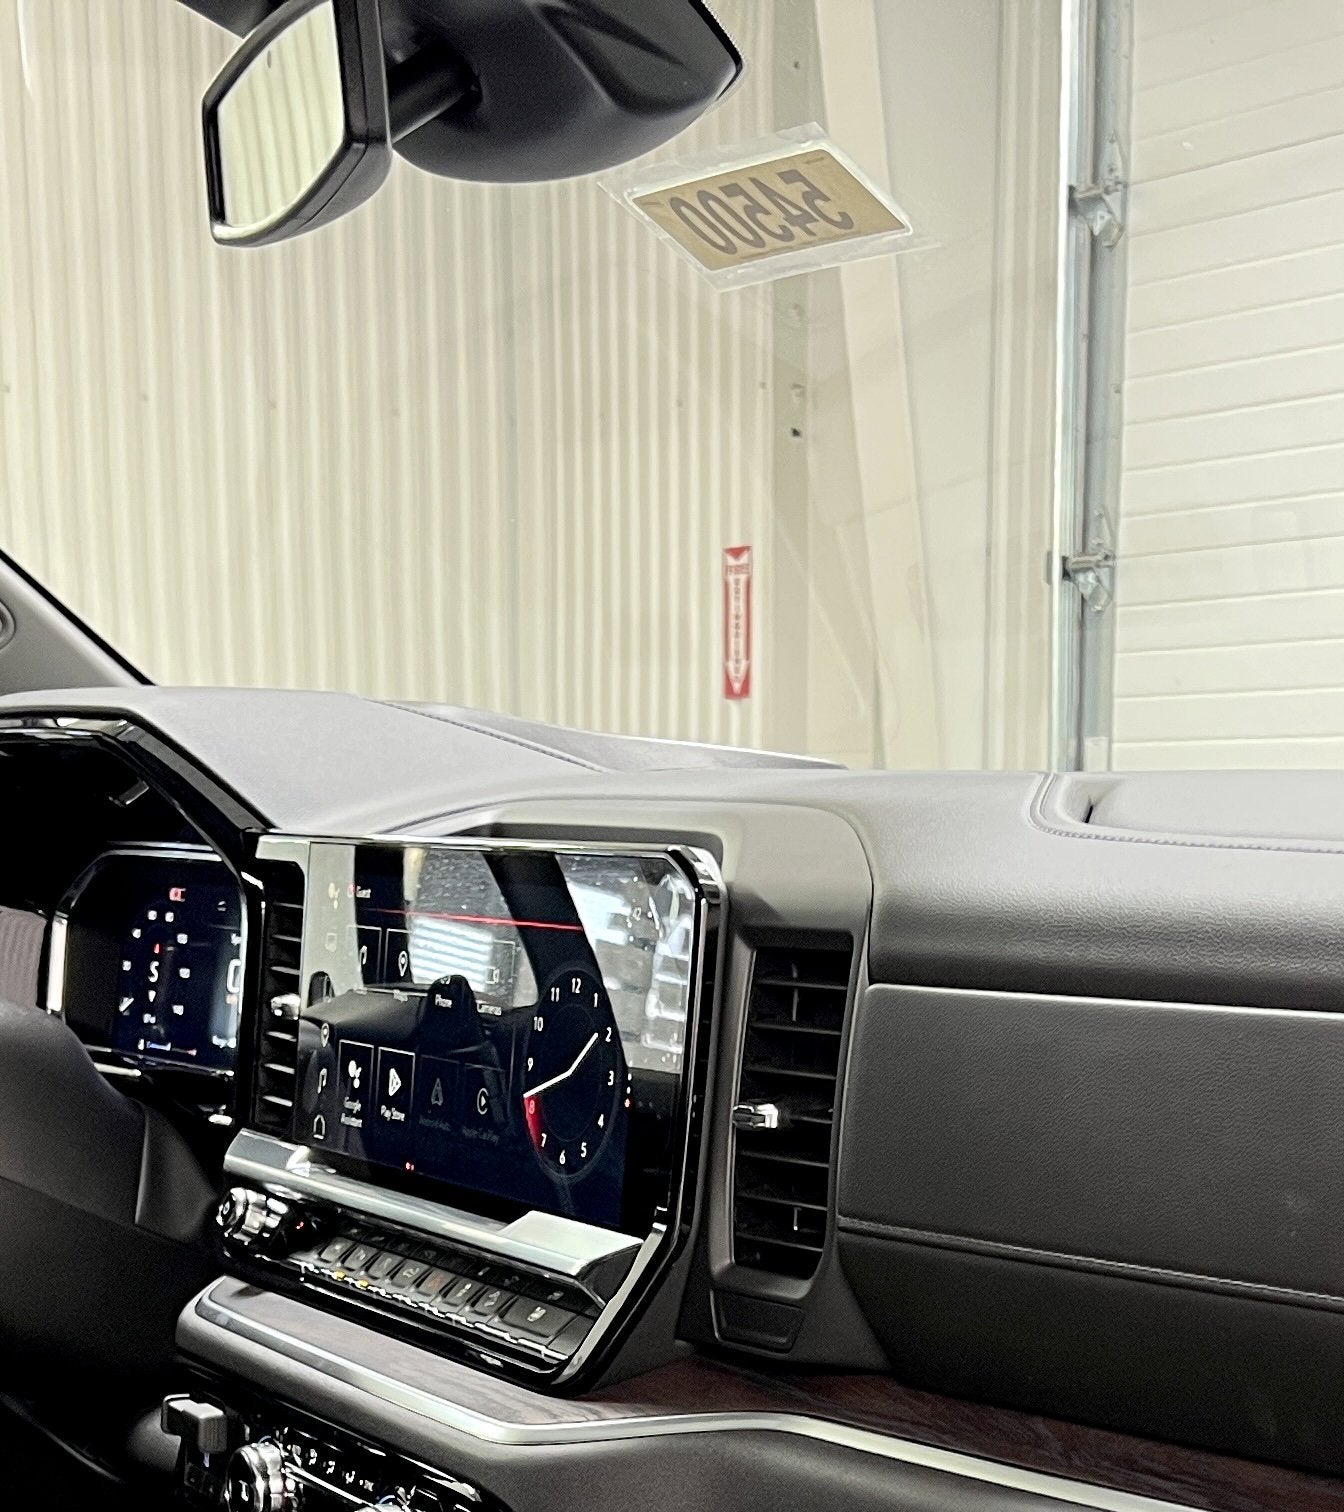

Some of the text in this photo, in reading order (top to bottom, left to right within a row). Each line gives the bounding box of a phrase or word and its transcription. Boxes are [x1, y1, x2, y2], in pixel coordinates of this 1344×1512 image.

[571, 978, 582, 994] 12
[551, 987, 560, 1002] 11
[593, 993, 599, 1008] 1
[533, 1016, 544, 1032] 10
[605, 1027, 612, 1042] 2
[527, 1057, 534, 1072] 9
[607, 1070, 615, 1086] 3
[597, 1114, 605, 1128] 4
[540, 1133, 547, 1148] 7
[559, 1150, 566, 1165] 6
[580, 1142, 587, 1158] 5
